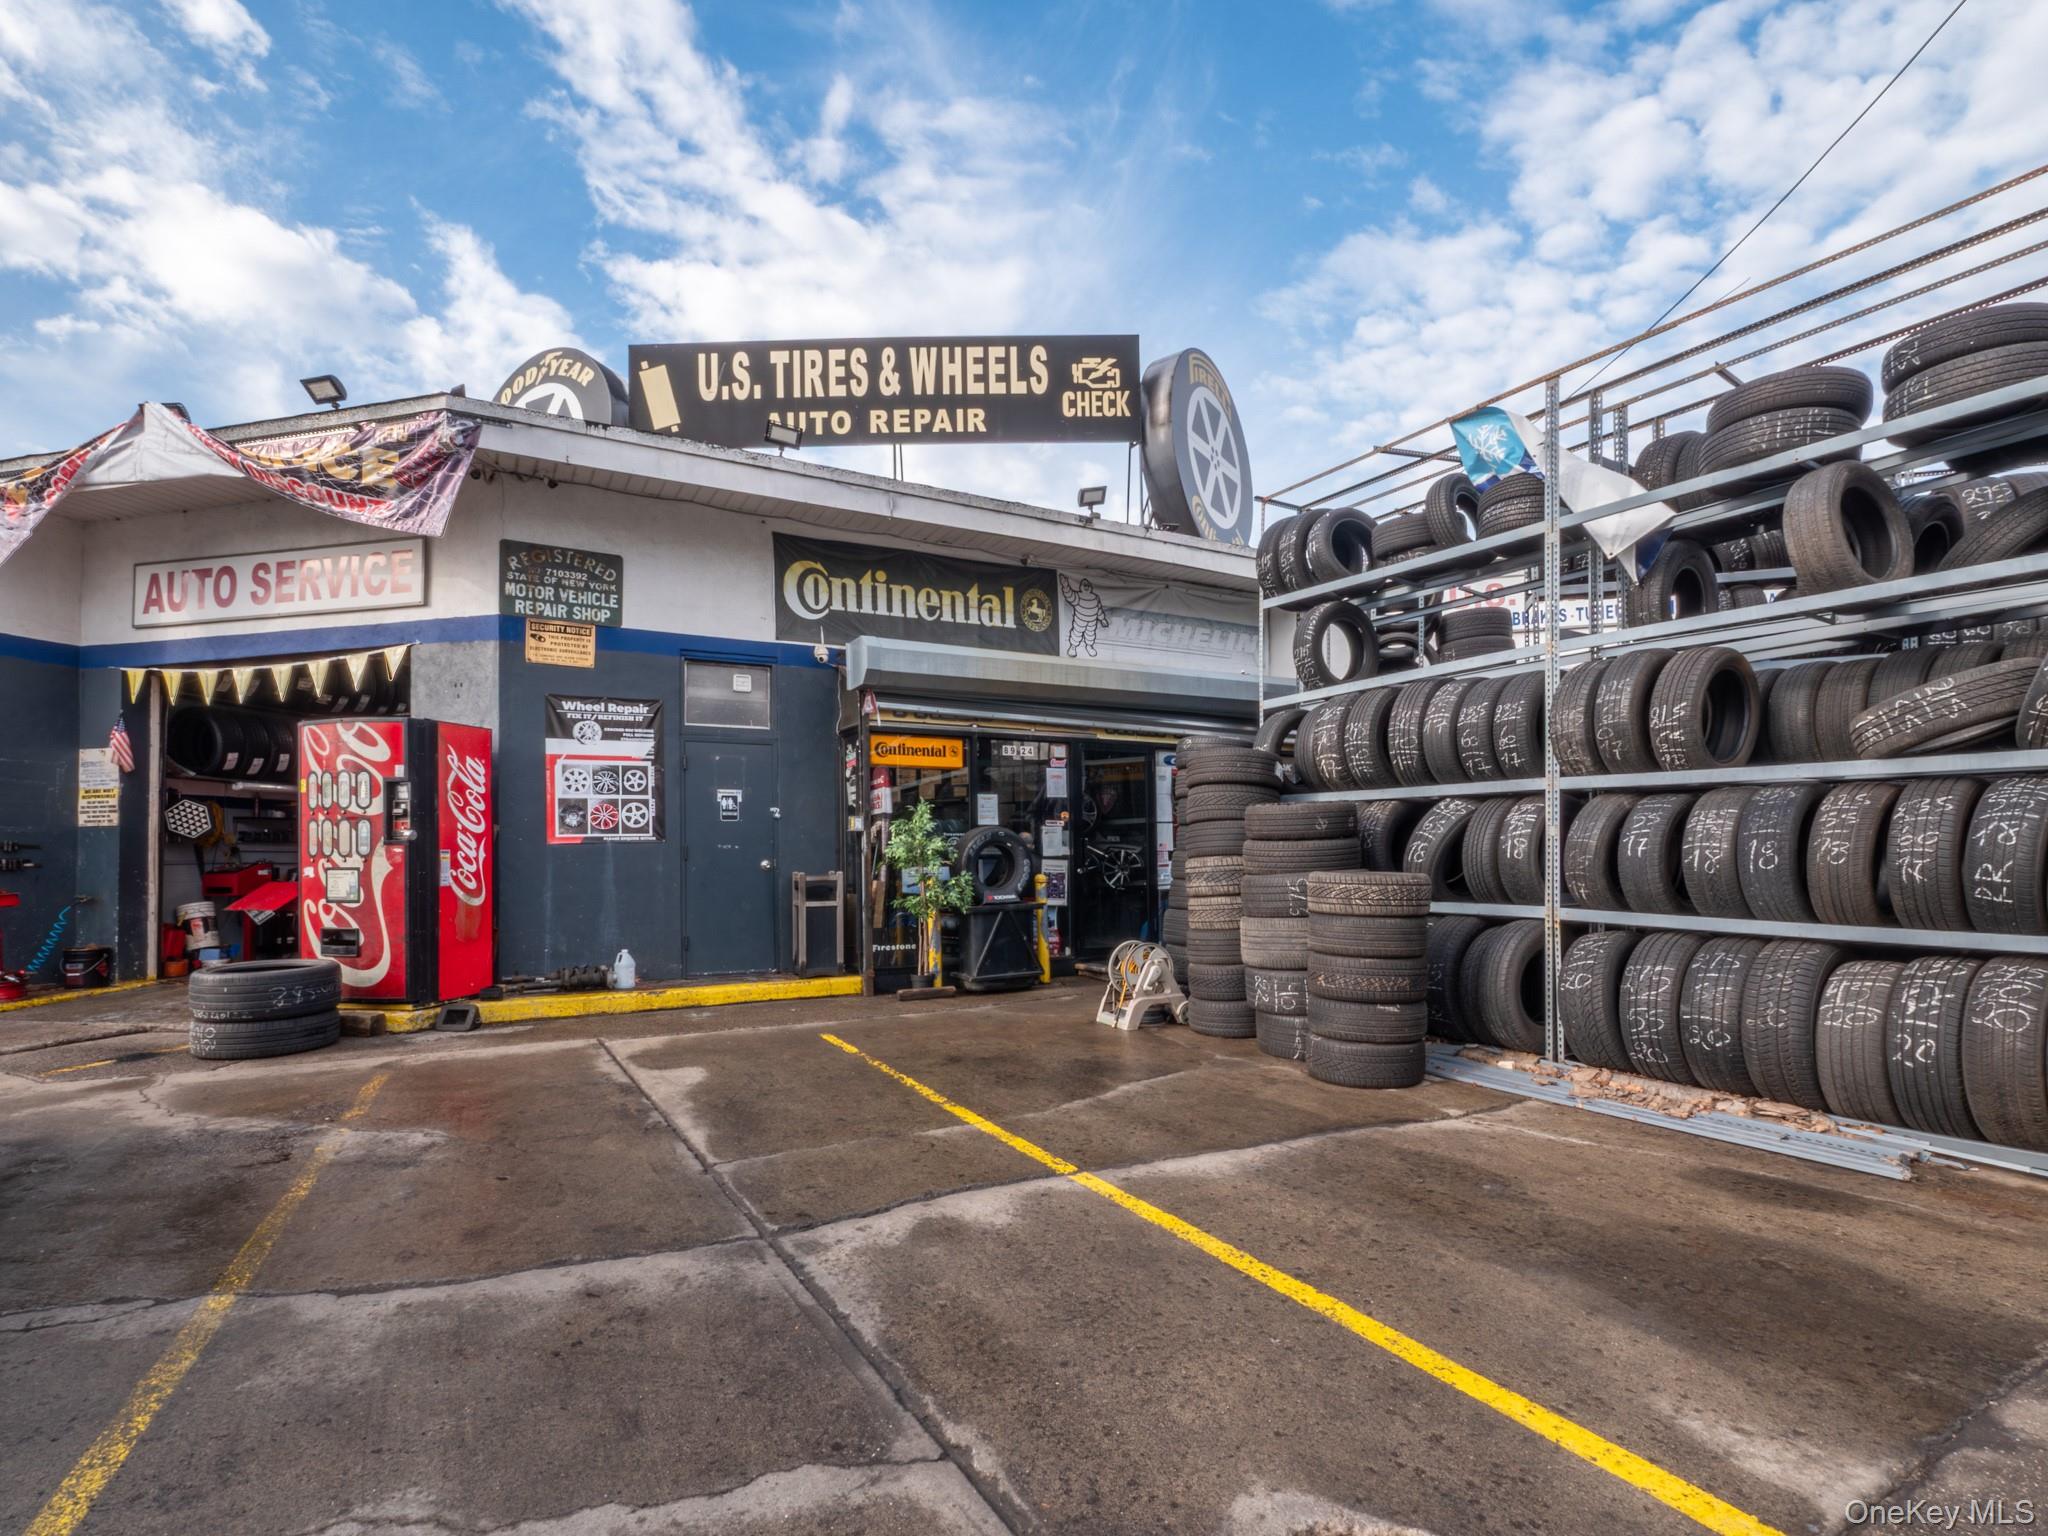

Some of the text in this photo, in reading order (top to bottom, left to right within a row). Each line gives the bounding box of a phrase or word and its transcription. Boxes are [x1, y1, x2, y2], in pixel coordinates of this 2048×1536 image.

[501, 354, 595, 405] OODYEAR
[698, 345, 1049, 401] U.S. TIRES & WHEELS
[1062, 390, 1131, 418] CHECK
[870, 408, 987, 434] REPAIR
[507, 548, 617, 582] REGISTERED
[545, 567, 589, 580] 7103392
[142, 549, 414, 616] AUTO SERVICE
[504, 581, 619, 609] MOTOR VEHICLE
[506, 571, 617, 592] STATE OF NEW YORK
[783, 560, 1017, 629] Continental
[514, 599, 611, 623] REPAIR SHOP
[1512, 608, 1568, 628] BRAKS
[530, 622, 592, 636] SECURITY NOTICE
[1107, 615, 1260, 655] MICHELIN
[561, 700, 650, 715] Wheel Repair
[874, 741, 947, 758] Continental
[447, 743, 487, 907] Coca-Cola
[872, 943, 917, 953] Firestone
